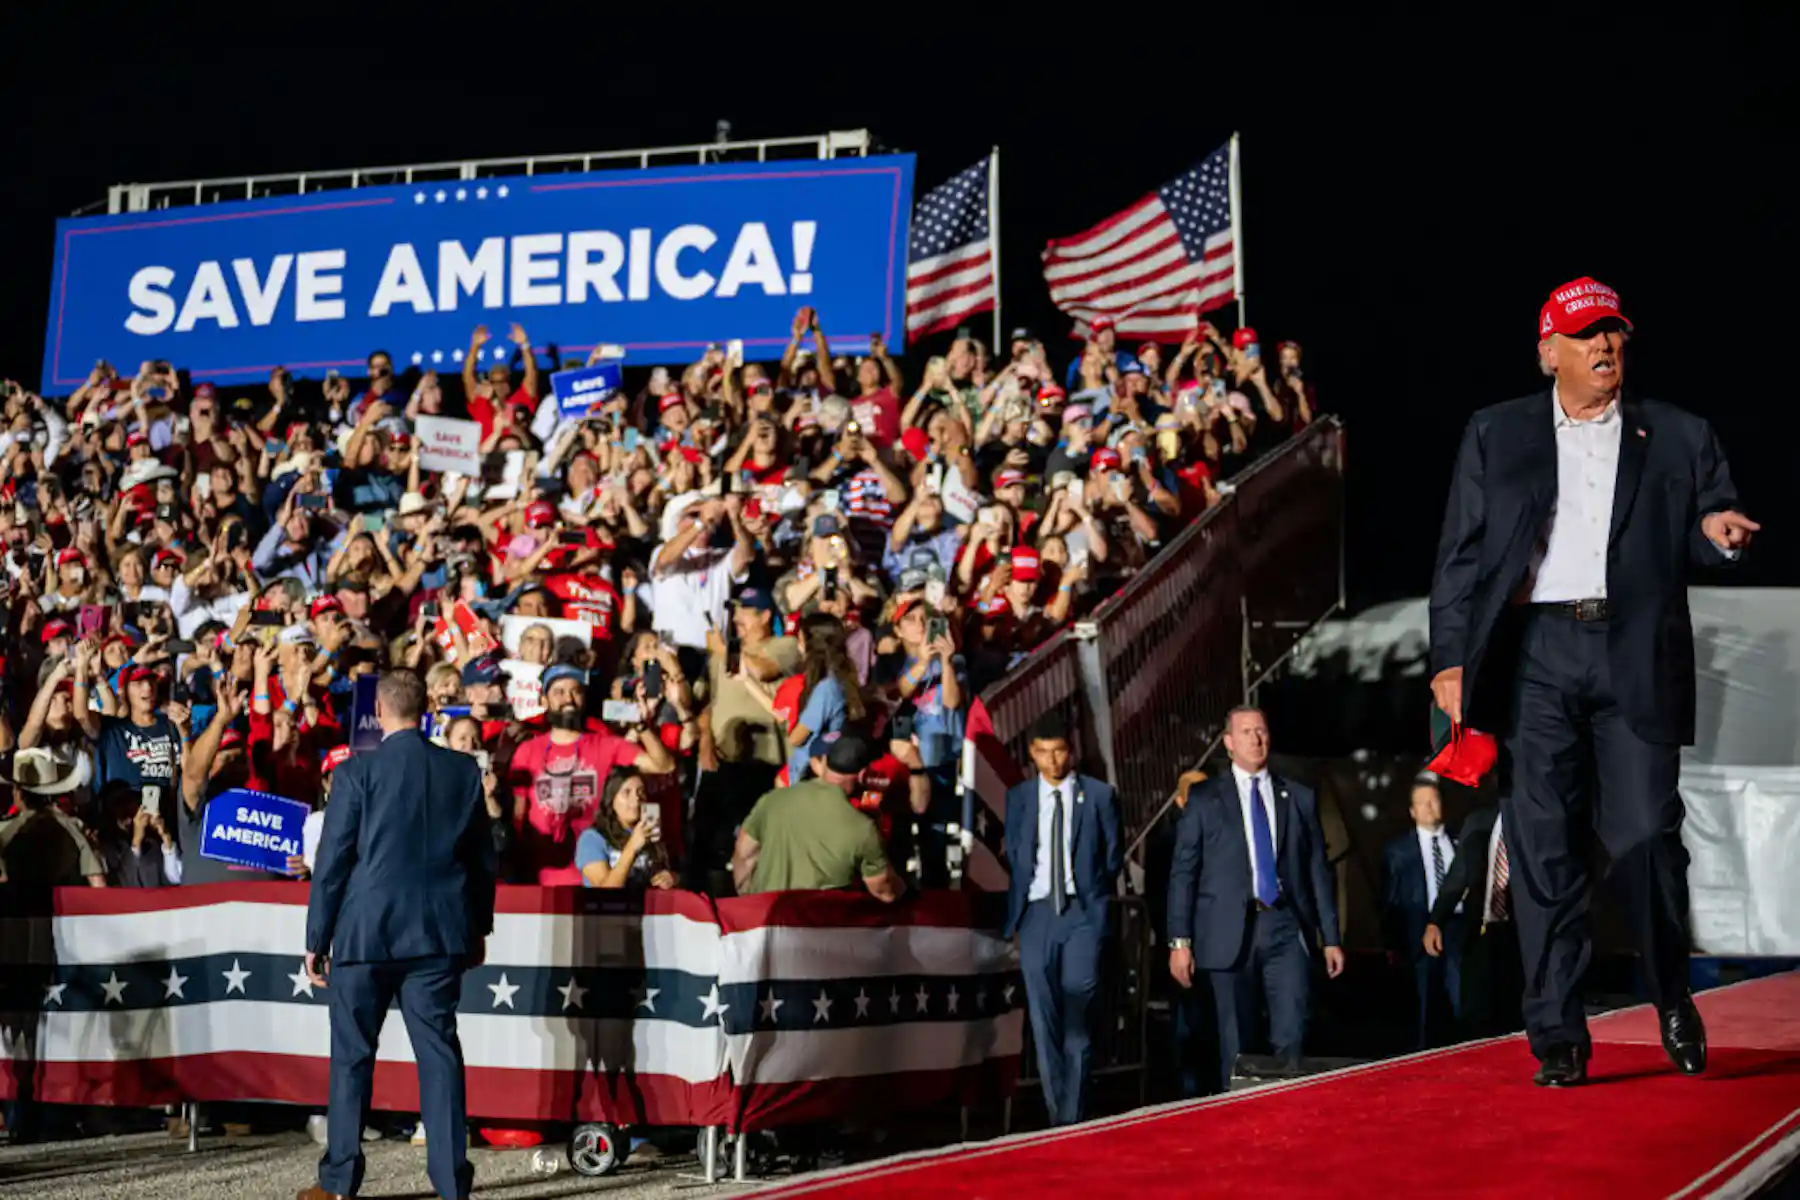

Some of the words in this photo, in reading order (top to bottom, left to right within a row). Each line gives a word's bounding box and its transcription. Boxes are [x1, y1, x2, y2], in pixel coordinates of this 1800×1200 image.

[124, 248, 348, 336] SAVE
[368, 220, 818, 317] AMERICA!
[1556, 285, 1583, 304] MAKE
[1565, 296, 1595, 315] GREAT
[236, 806, 284, 831] SAVE
[211, 823, 300, 857] AMERICA!
